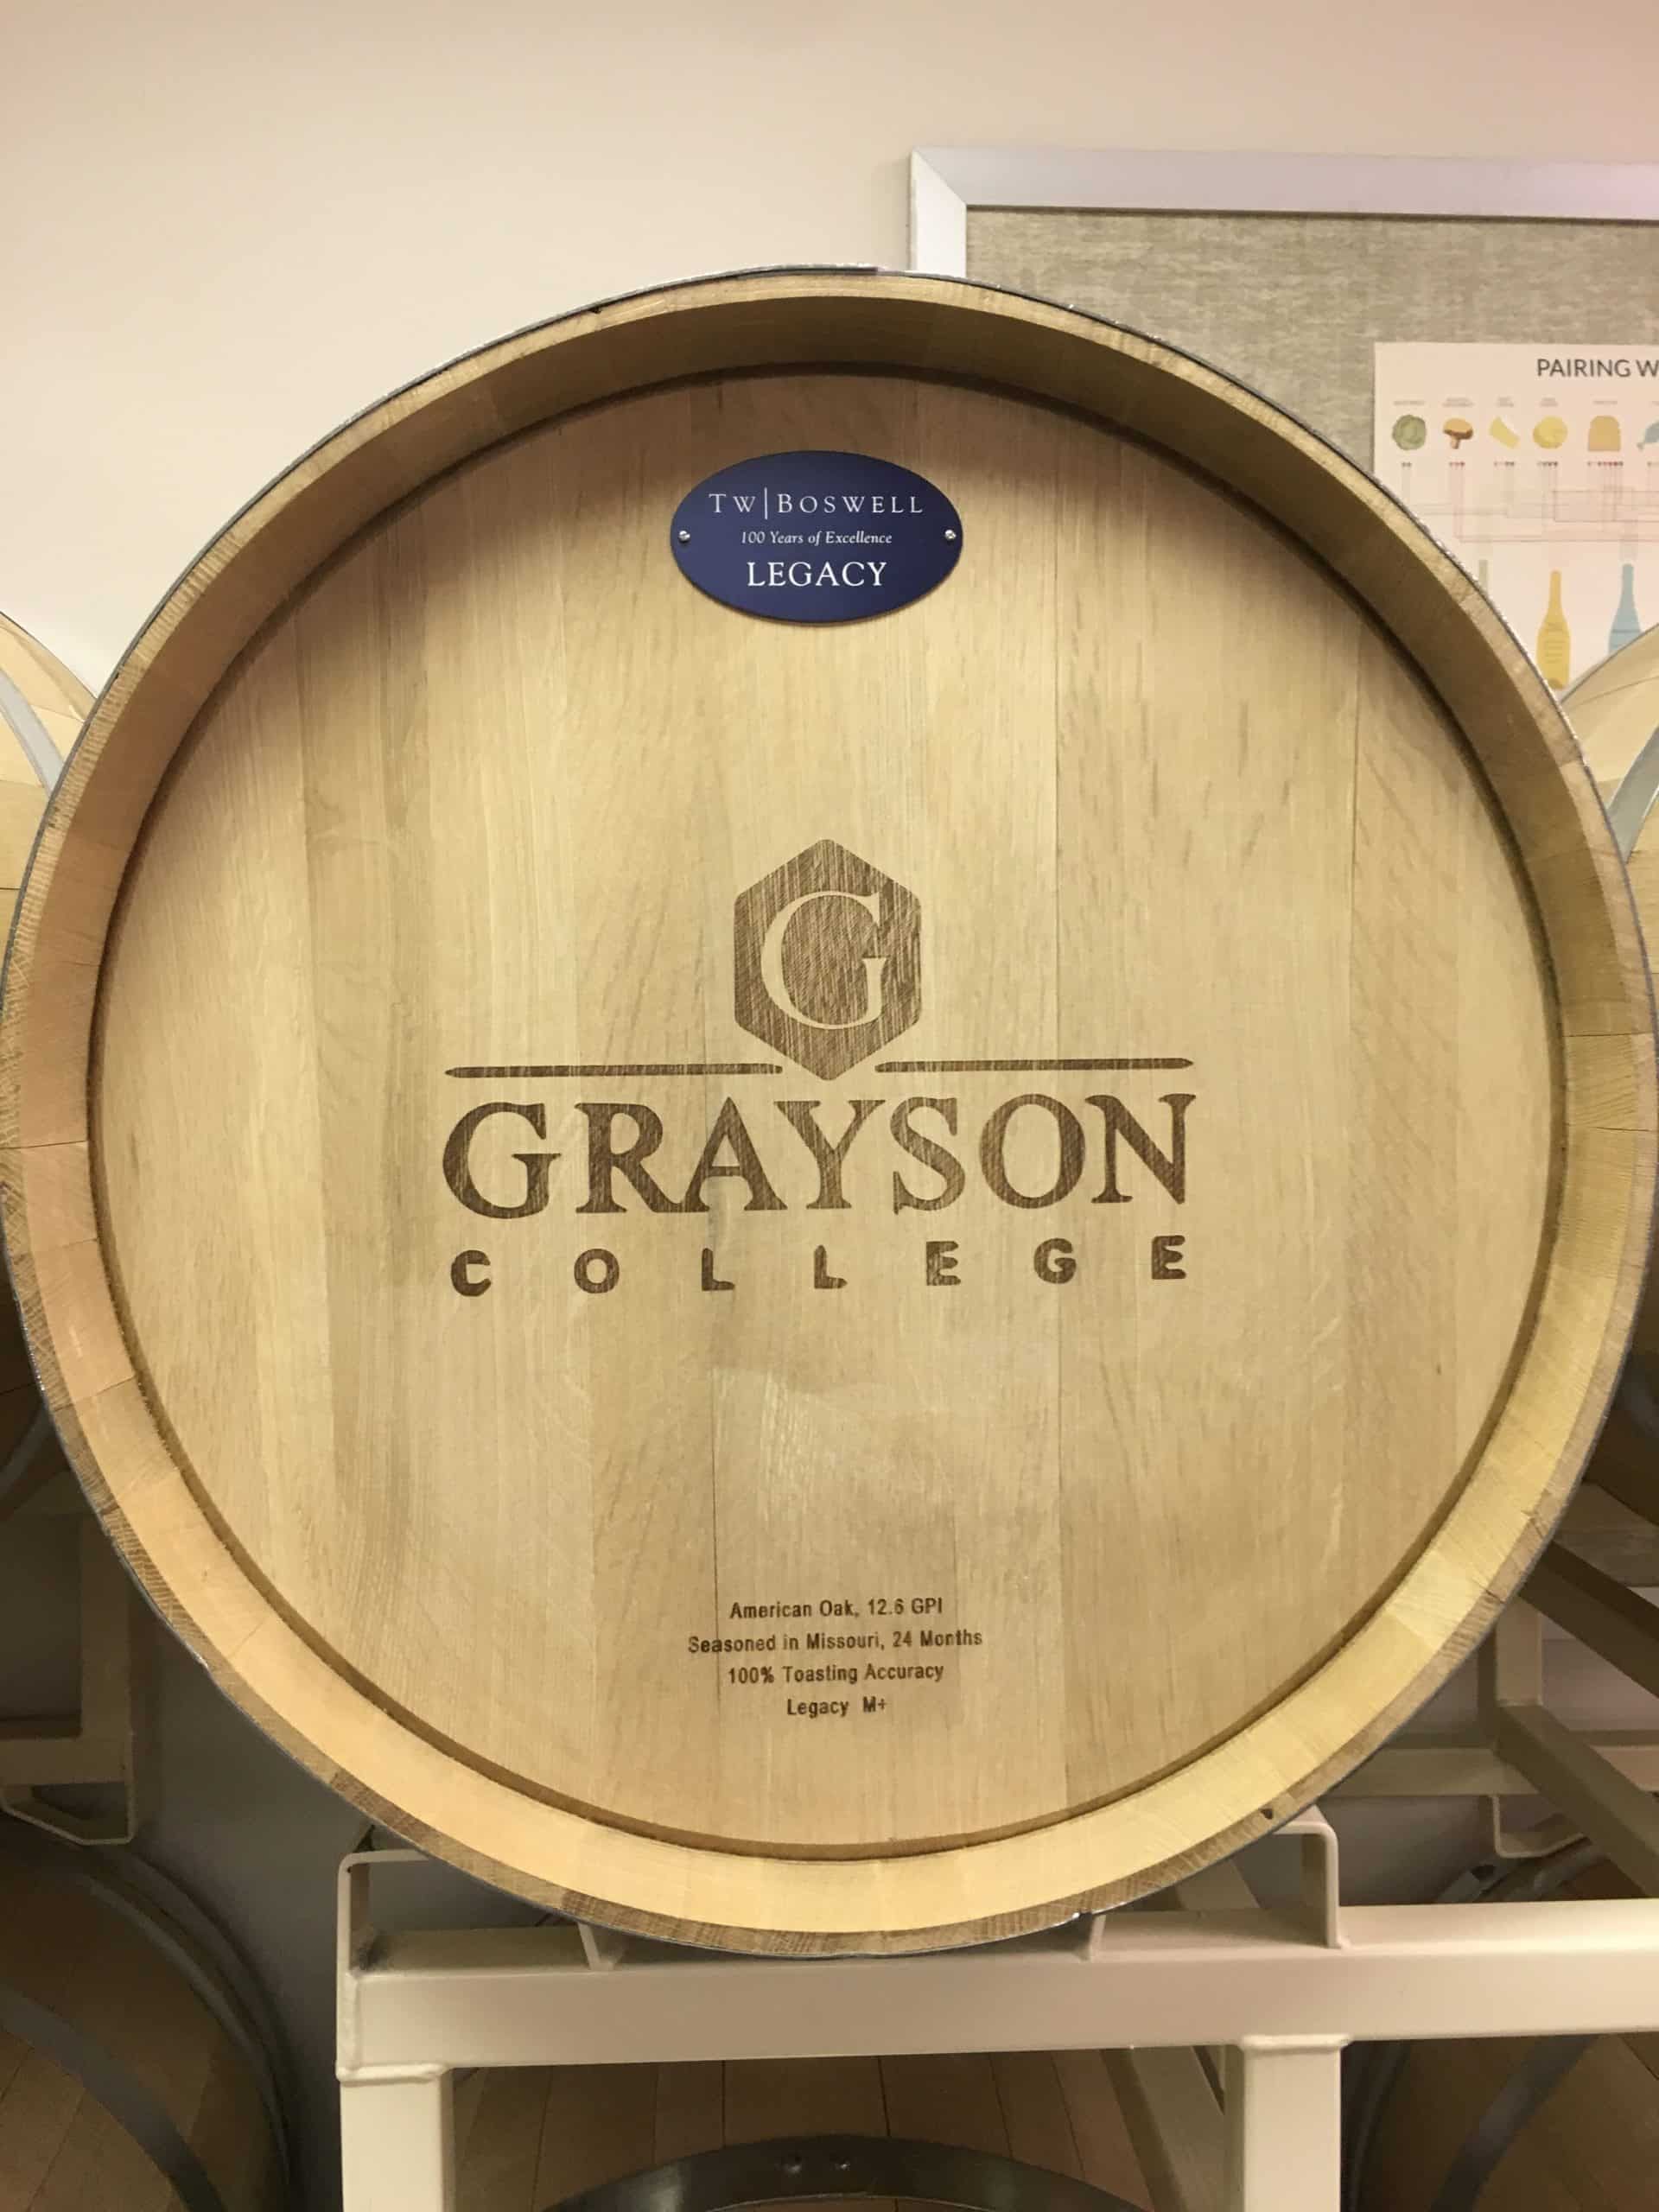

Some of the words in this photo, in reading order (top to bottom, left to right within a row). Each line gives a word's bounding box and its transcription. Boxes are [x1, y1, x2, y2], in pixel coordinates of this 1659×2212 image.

[1537, 359, 1631, 378] PAIRING
[777, 493, 924, 514] BOSWELL
[741, 531, 766, 544] 100
[771, 531, 804, 544] Years
[808, 530, 823, 547] of
[824, 530, 893, 544] Excellence
[747, 561, 887, 587] LEGACY
[760, 890, 887, 1030] G
[442, 1092, 1197, 1220] GRAYSON
[450, 1235, 1187, 1297] COLLEGE
[729, 1601, 812, 1619] American
[819, 1599, 860, 1618] Oak,
[867, 1598, 905, 1616] 12.6
[911, 1596, 944, 1615] GPI
[688, 1634, 777, 1654] Seasoned
[783, 1633, 800, 1651] in
[806, 1631, 887, 1651] Missouri,
[892, 1630, 913, 1649] 24
[919, 1628, 983, 1648] Months
[728, 1666, 775, 1685] 100%
[781, 1664, 859, 1686] Toasting
[865, 1662, 944, 1682] Accuracy
[786, 1698, 849, 1719] Legacy
[862, 1695, 887, 1714] M+
